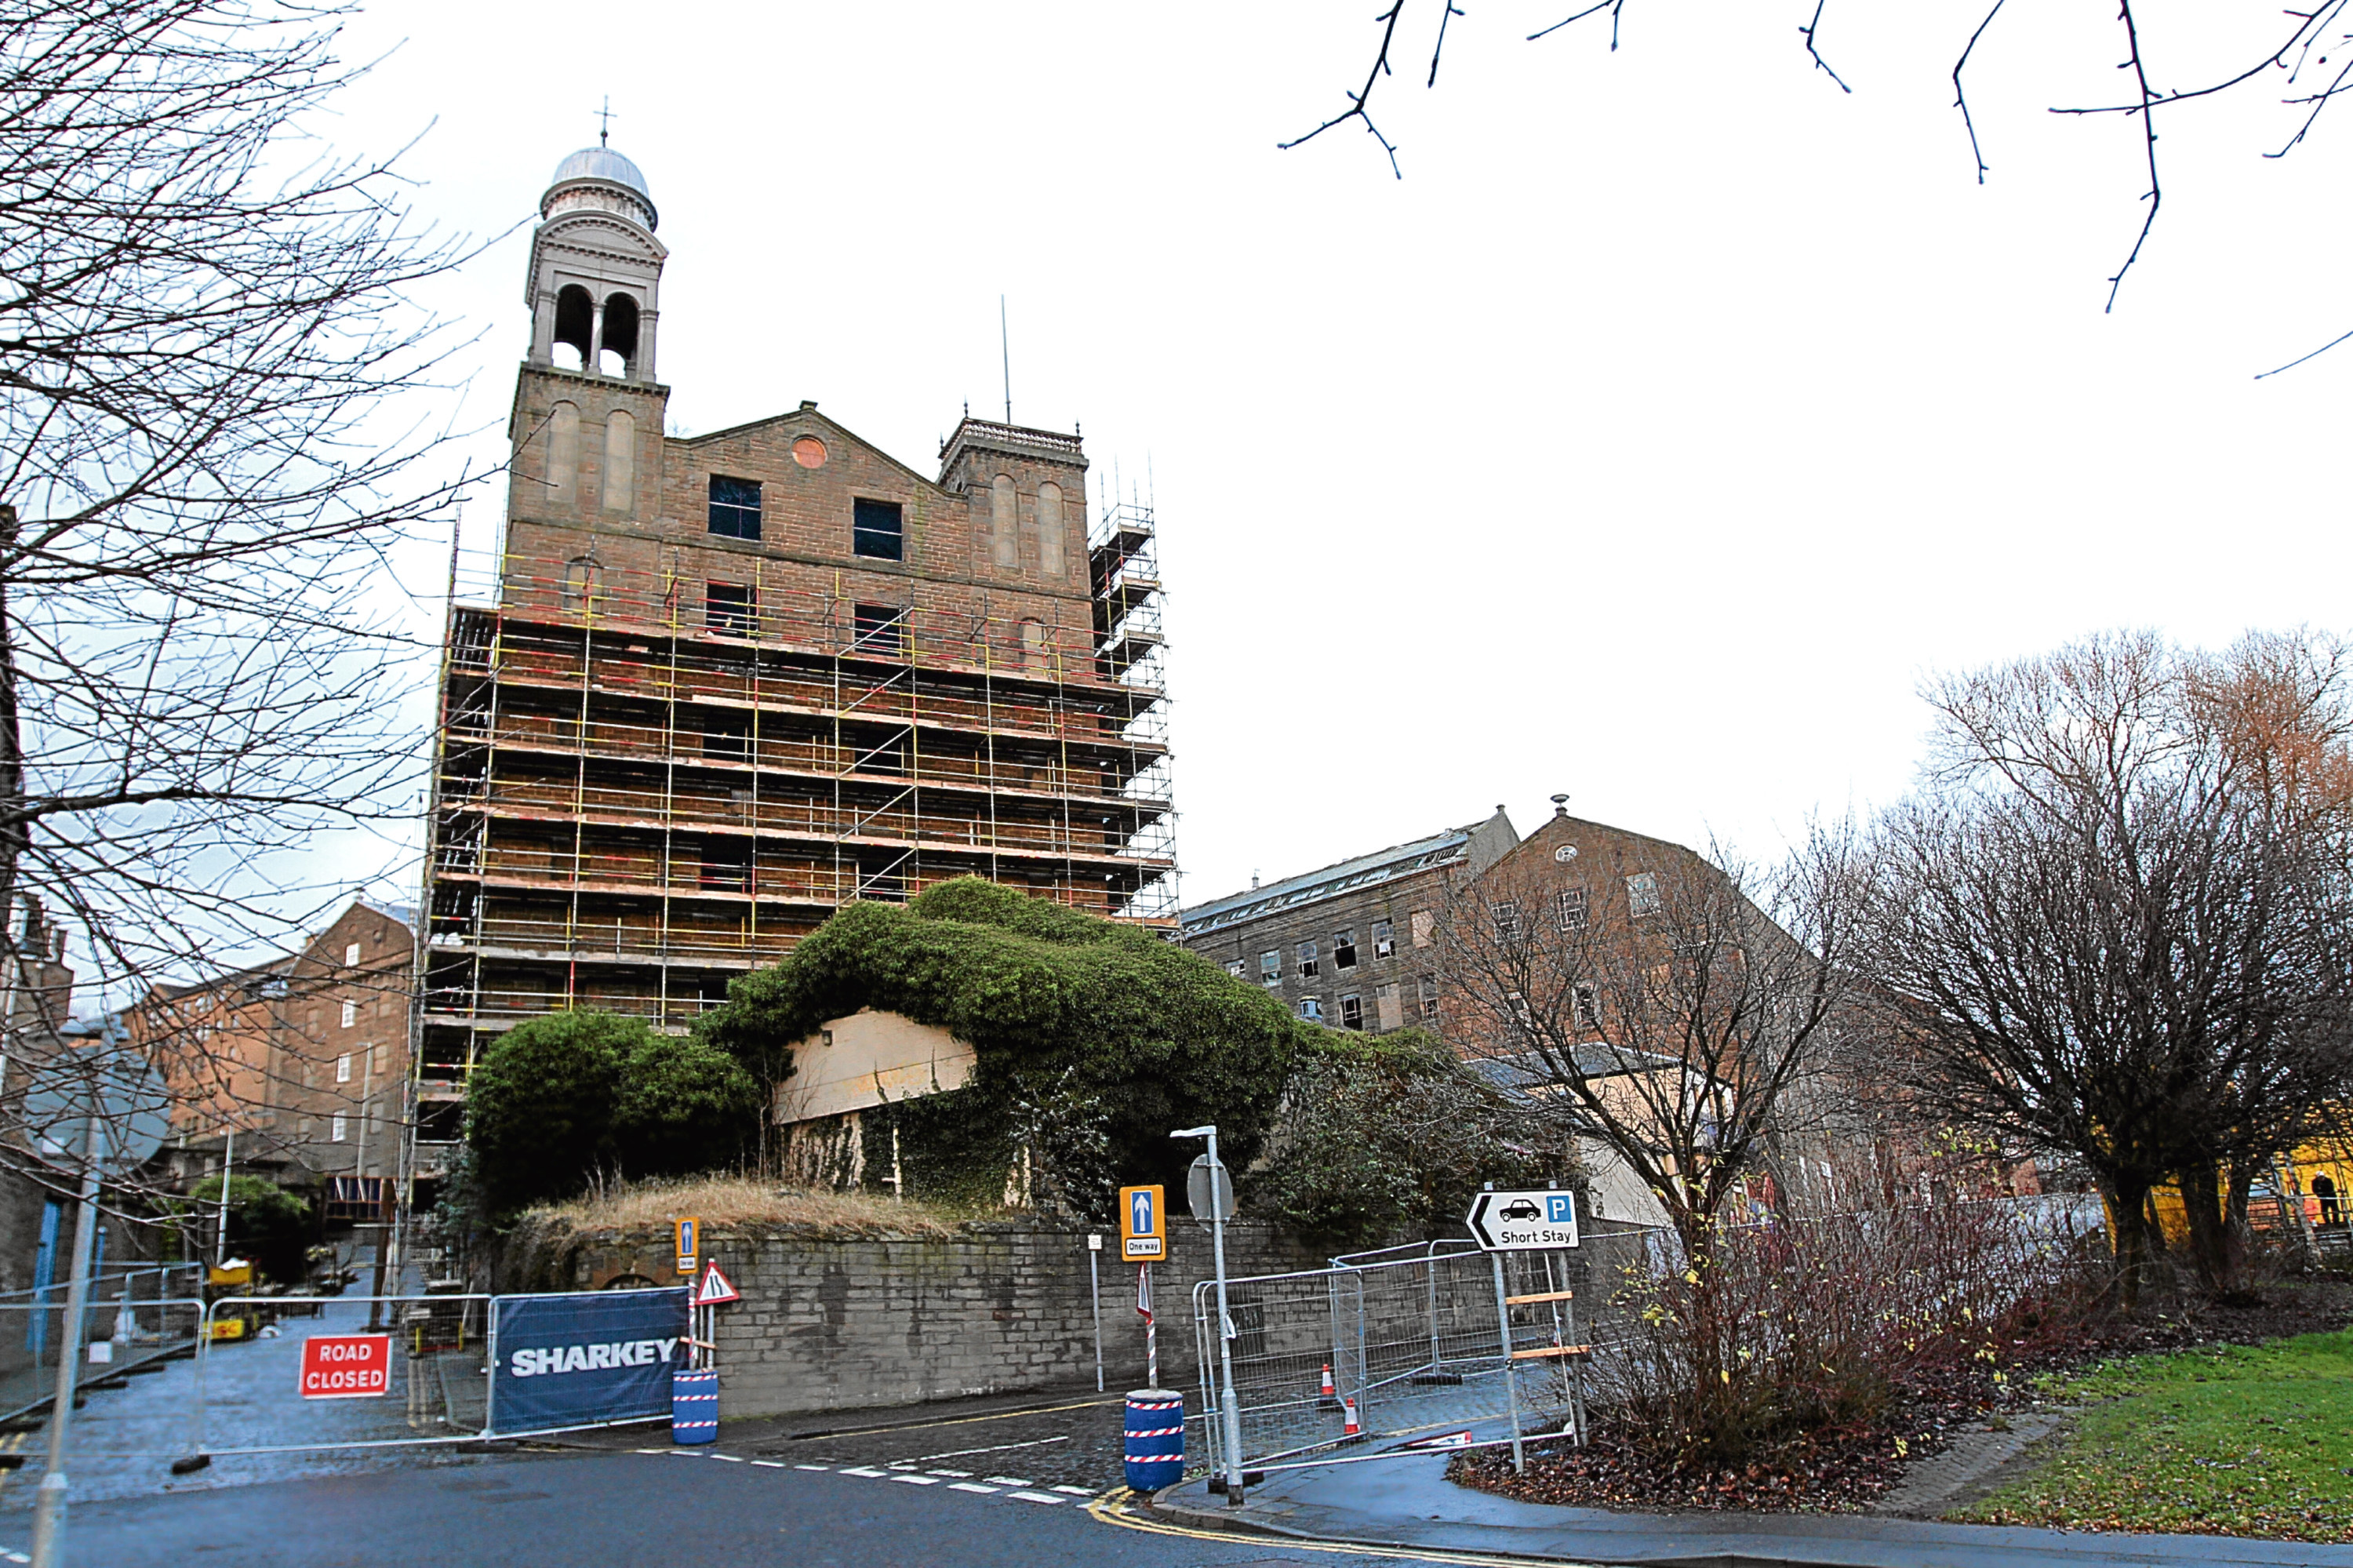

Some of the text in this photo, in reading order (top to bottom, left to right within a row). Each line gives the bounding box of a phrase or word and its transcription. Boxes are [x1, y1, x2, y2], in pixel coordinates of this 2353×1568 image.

[1551, 1199, 1566, 1220] P
[1501, 1229, 1571, 1243] Short Stay
[320, 1344, 373, 1362] ROAD
[511, 1337, 678, 1377] SHARKEY
[307, 1370, 384, 1389] CLOSED
